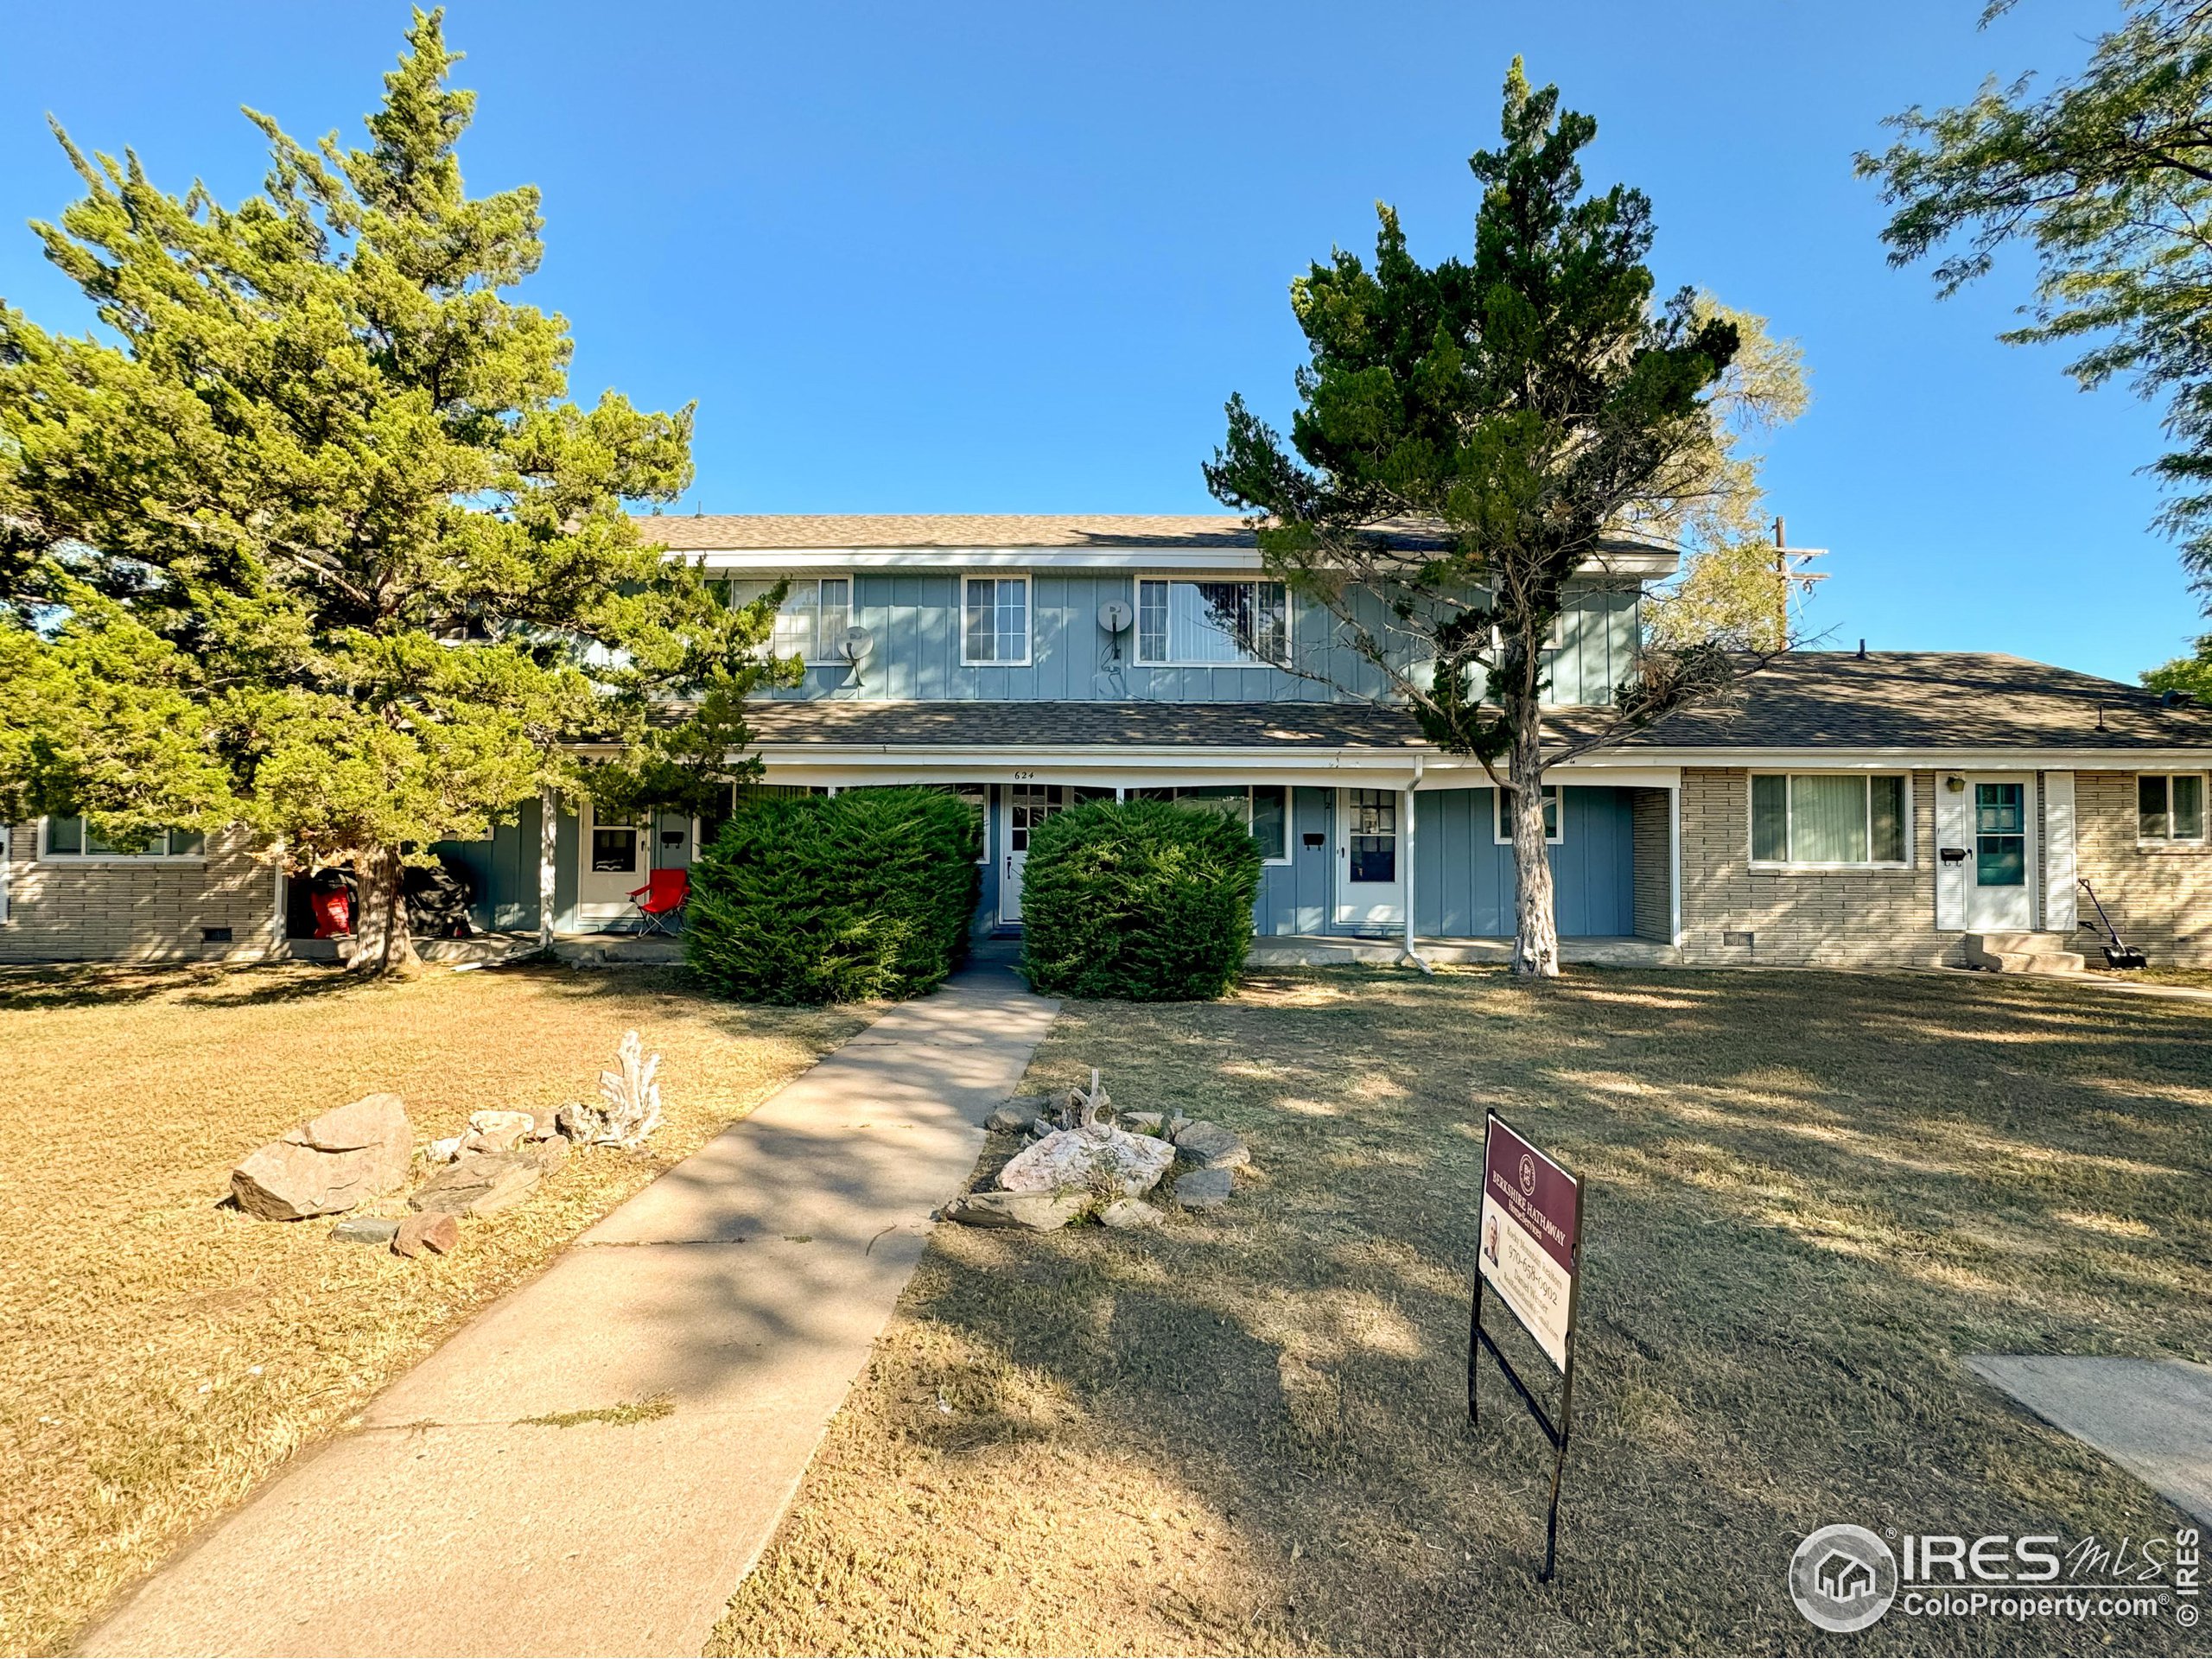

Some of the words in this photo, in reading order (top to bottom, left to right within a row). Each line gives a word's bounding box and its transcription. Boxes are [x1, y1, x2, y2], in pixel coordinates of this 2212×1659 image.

[1014, 771, 1034, 779] 624
[1492, 1169, 1527, 1211] BERKSHIRE
[1527, 1201, 1566, 1247] HATHAWAY
[1508, 1198, 1542, 1240] HomeServices
[1509, 1244, 1558, 1306] 970-658-0902
